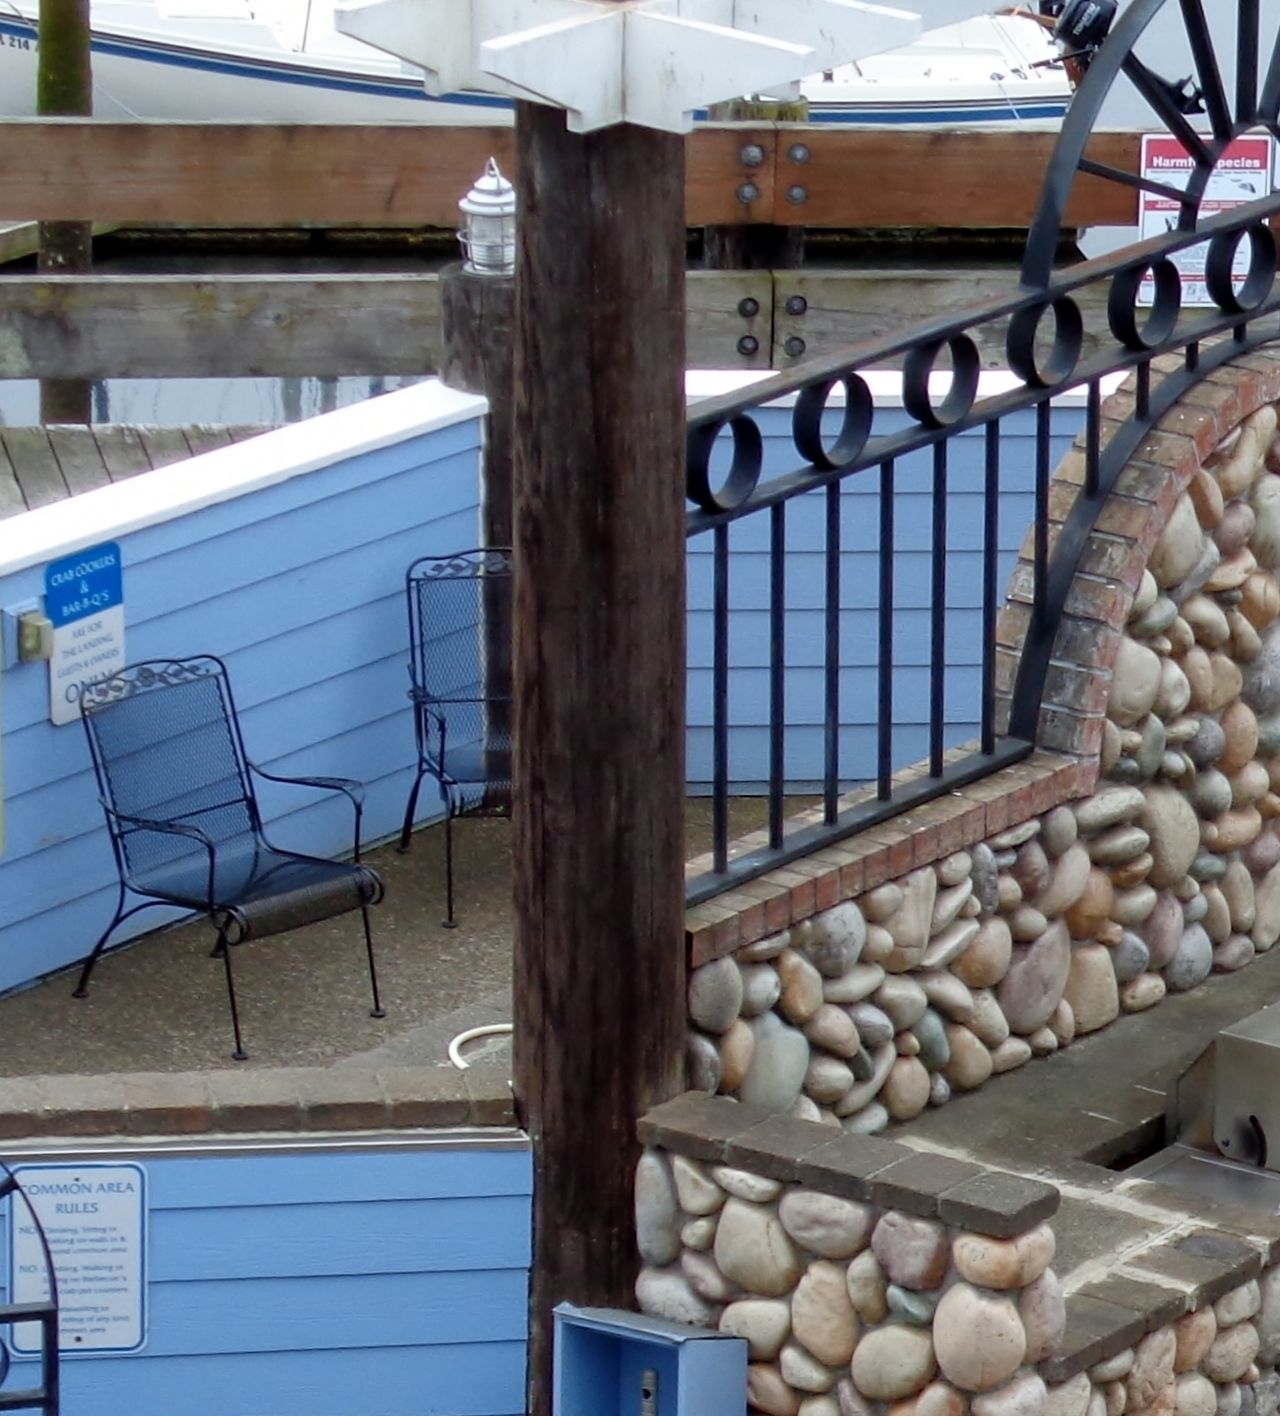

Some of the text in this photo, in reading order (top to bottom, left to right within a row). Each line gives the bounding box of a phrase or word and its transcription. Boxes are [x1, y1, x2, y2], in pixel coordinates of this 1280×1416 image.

[1216, 157, 1260, 168] pecies
[96, 1181, 135, 1194] AREA
[55, 1202, 99, 1214] RULES
